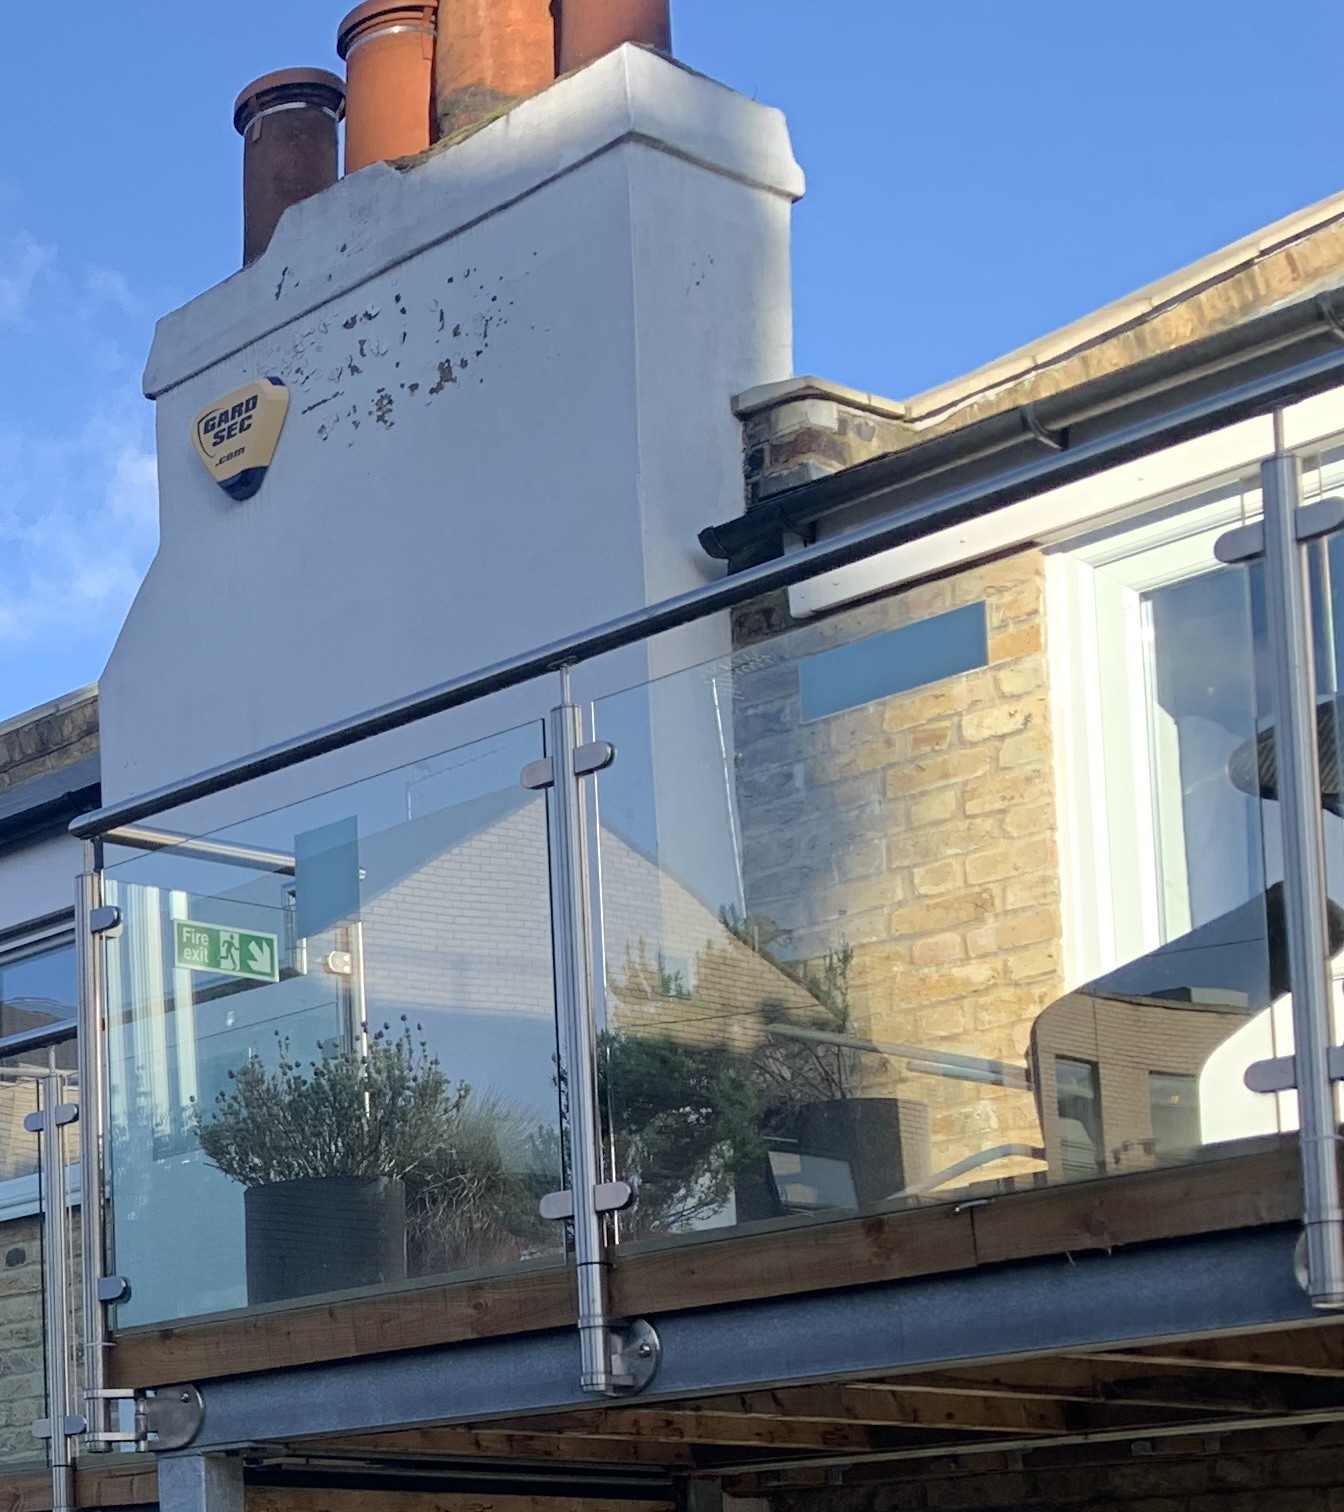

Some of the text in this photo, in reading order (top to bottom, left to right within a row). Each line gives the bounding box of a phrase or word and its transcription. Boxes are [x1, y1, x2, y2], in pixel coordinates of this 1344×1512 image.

[203, 394, 259, 435] GARD
[212, 414, 253, 447] SEC
[214, 446, 246, 467] .com
[182, 926, 210, 946] Fire
[183, 945, 210, 964] exit
